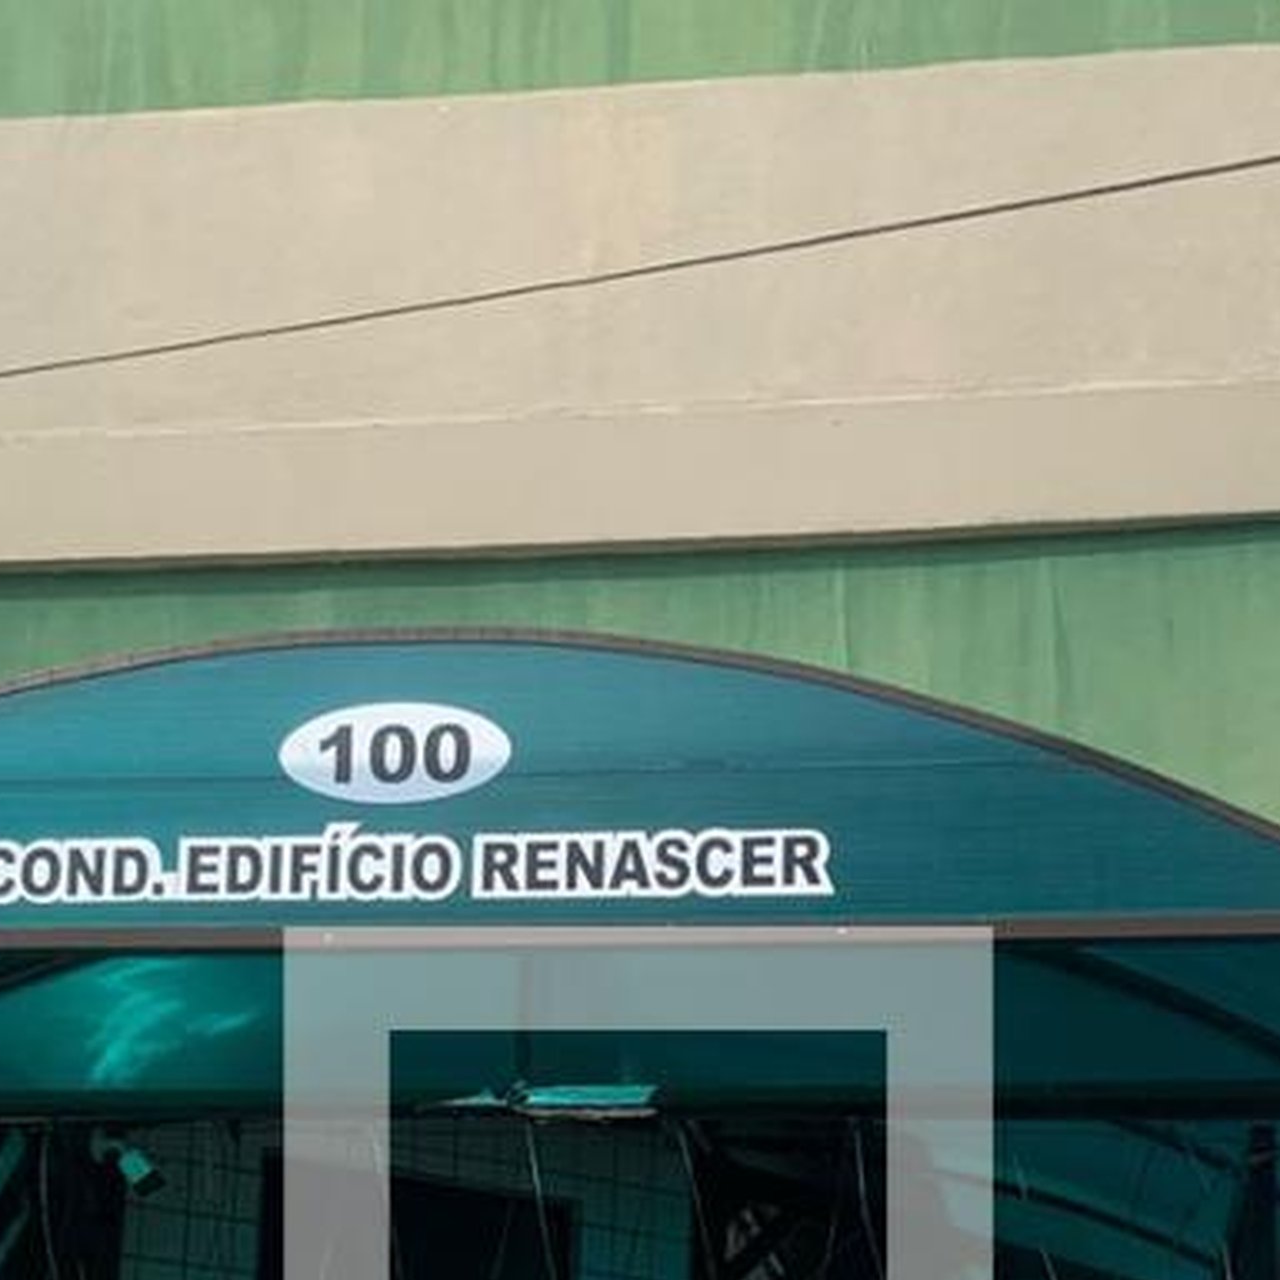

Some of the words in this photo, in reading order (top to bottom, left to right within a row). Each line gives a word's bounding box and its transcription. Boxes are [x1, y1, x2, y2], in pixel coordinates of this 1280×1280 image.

[320, 724, 471, 784] 100
[186, 826, 453, 894] EDIFÍCIO
[481, 838, 822, 891] RENASCER
